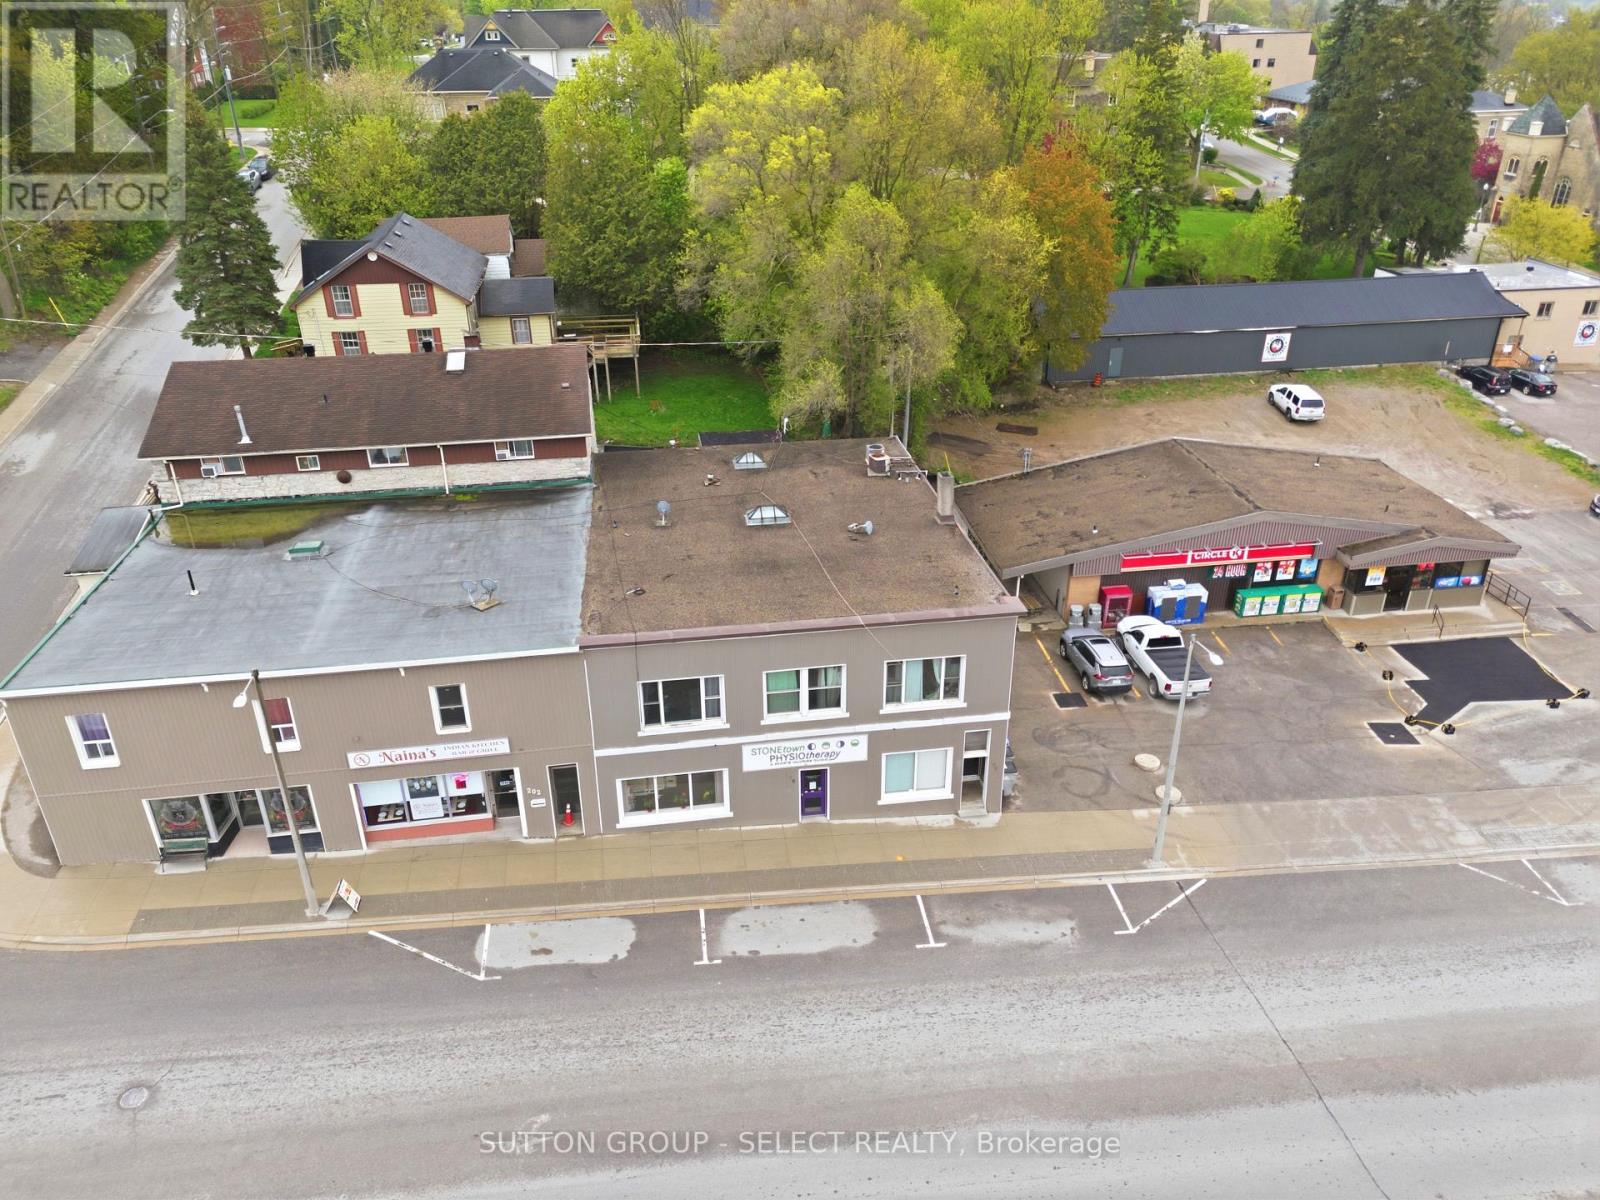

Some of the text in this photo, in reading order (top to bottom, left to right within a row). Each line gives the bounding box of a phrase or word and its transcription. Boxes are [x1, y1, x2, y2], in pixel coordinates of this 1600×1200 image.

[1194, 550, 1228, 560] CIRCLE
[379, 747, 437, 763] Naina's
[751, 745, 805, 756] STONEtown
[769, 750, 841, 763] PHYSIOtherapy
[526, 787, 542, 796] 202
